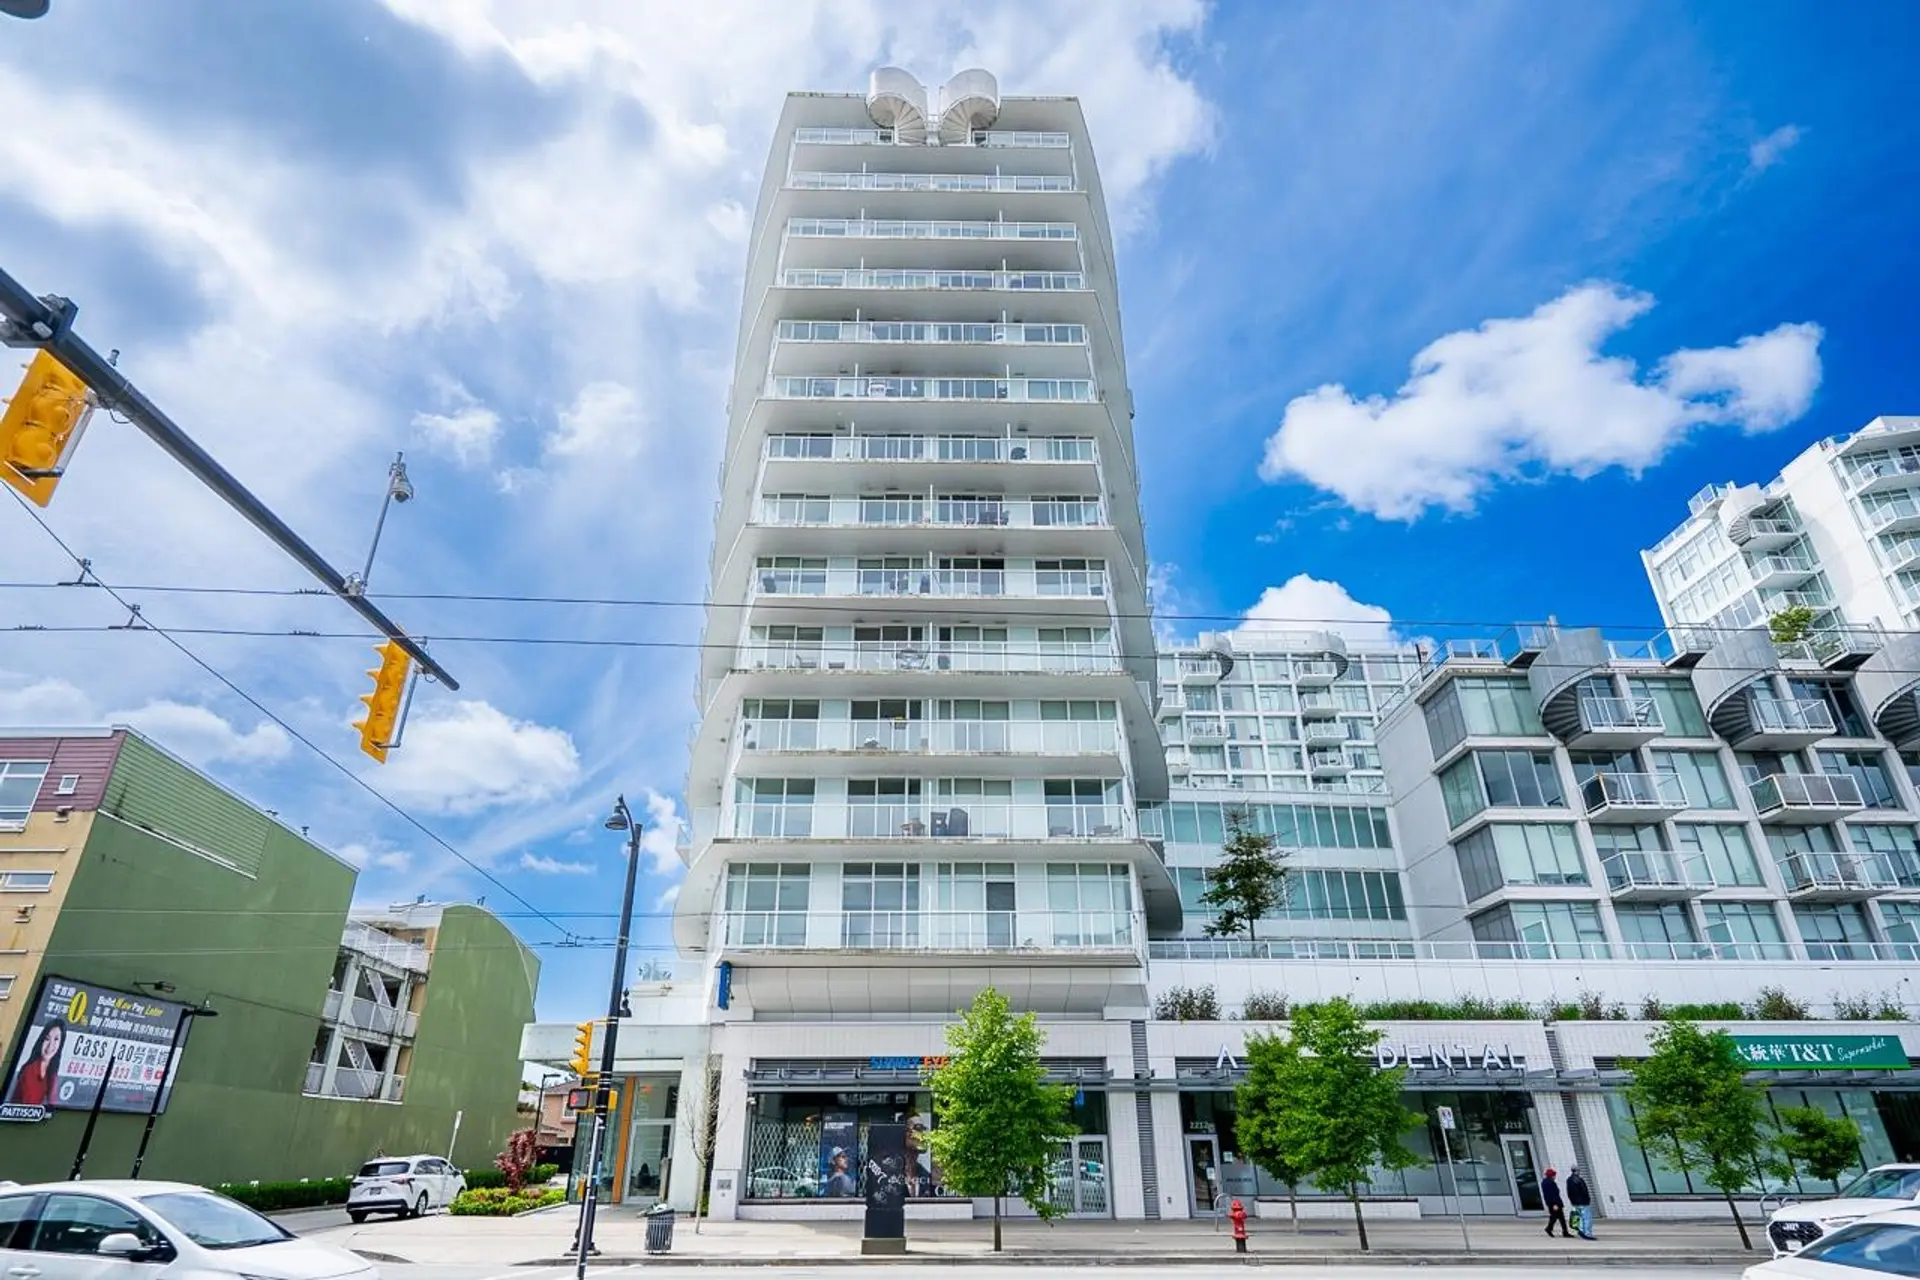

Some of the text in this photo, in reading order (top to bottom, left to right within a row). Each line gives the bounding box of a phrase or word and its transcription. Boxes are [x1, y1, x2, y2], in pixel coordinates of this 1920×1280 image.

[73, 1035, 107, 1059] Cass
[112, 1040, 135, 1062] Lao
[1375, 1043, 1526, 1070] DENTAL
[1784, 1043, 1835, 1062] T&T
[1837, 1036, 1886, 1062] Supermarket
[1, 1107, 42, 1118] PATTISON
